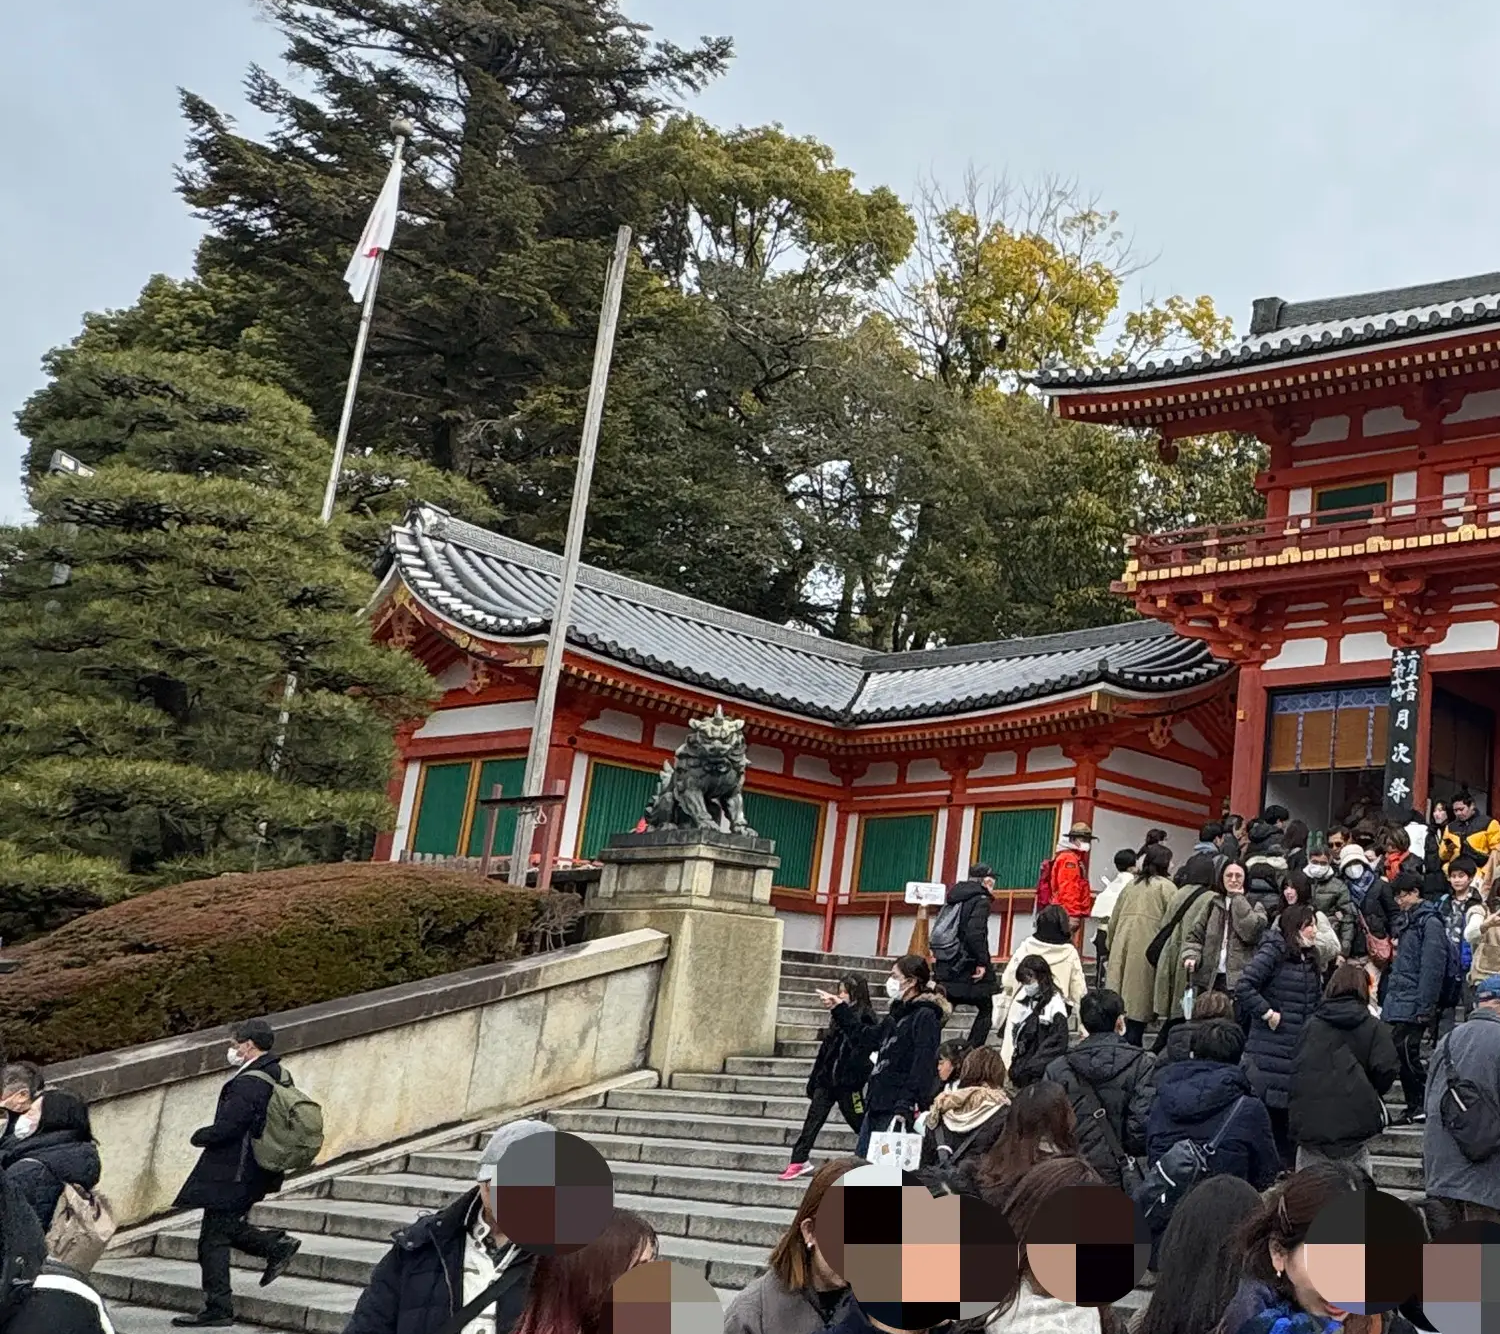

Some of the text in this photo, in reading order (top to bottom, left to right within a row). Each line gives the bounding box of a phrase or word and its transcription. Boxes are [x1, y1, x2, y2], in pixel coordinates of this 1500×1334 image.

[1405, 650, 1420, 702] 二月十五日
[1387, 709, 1412, 804] 月次祭
